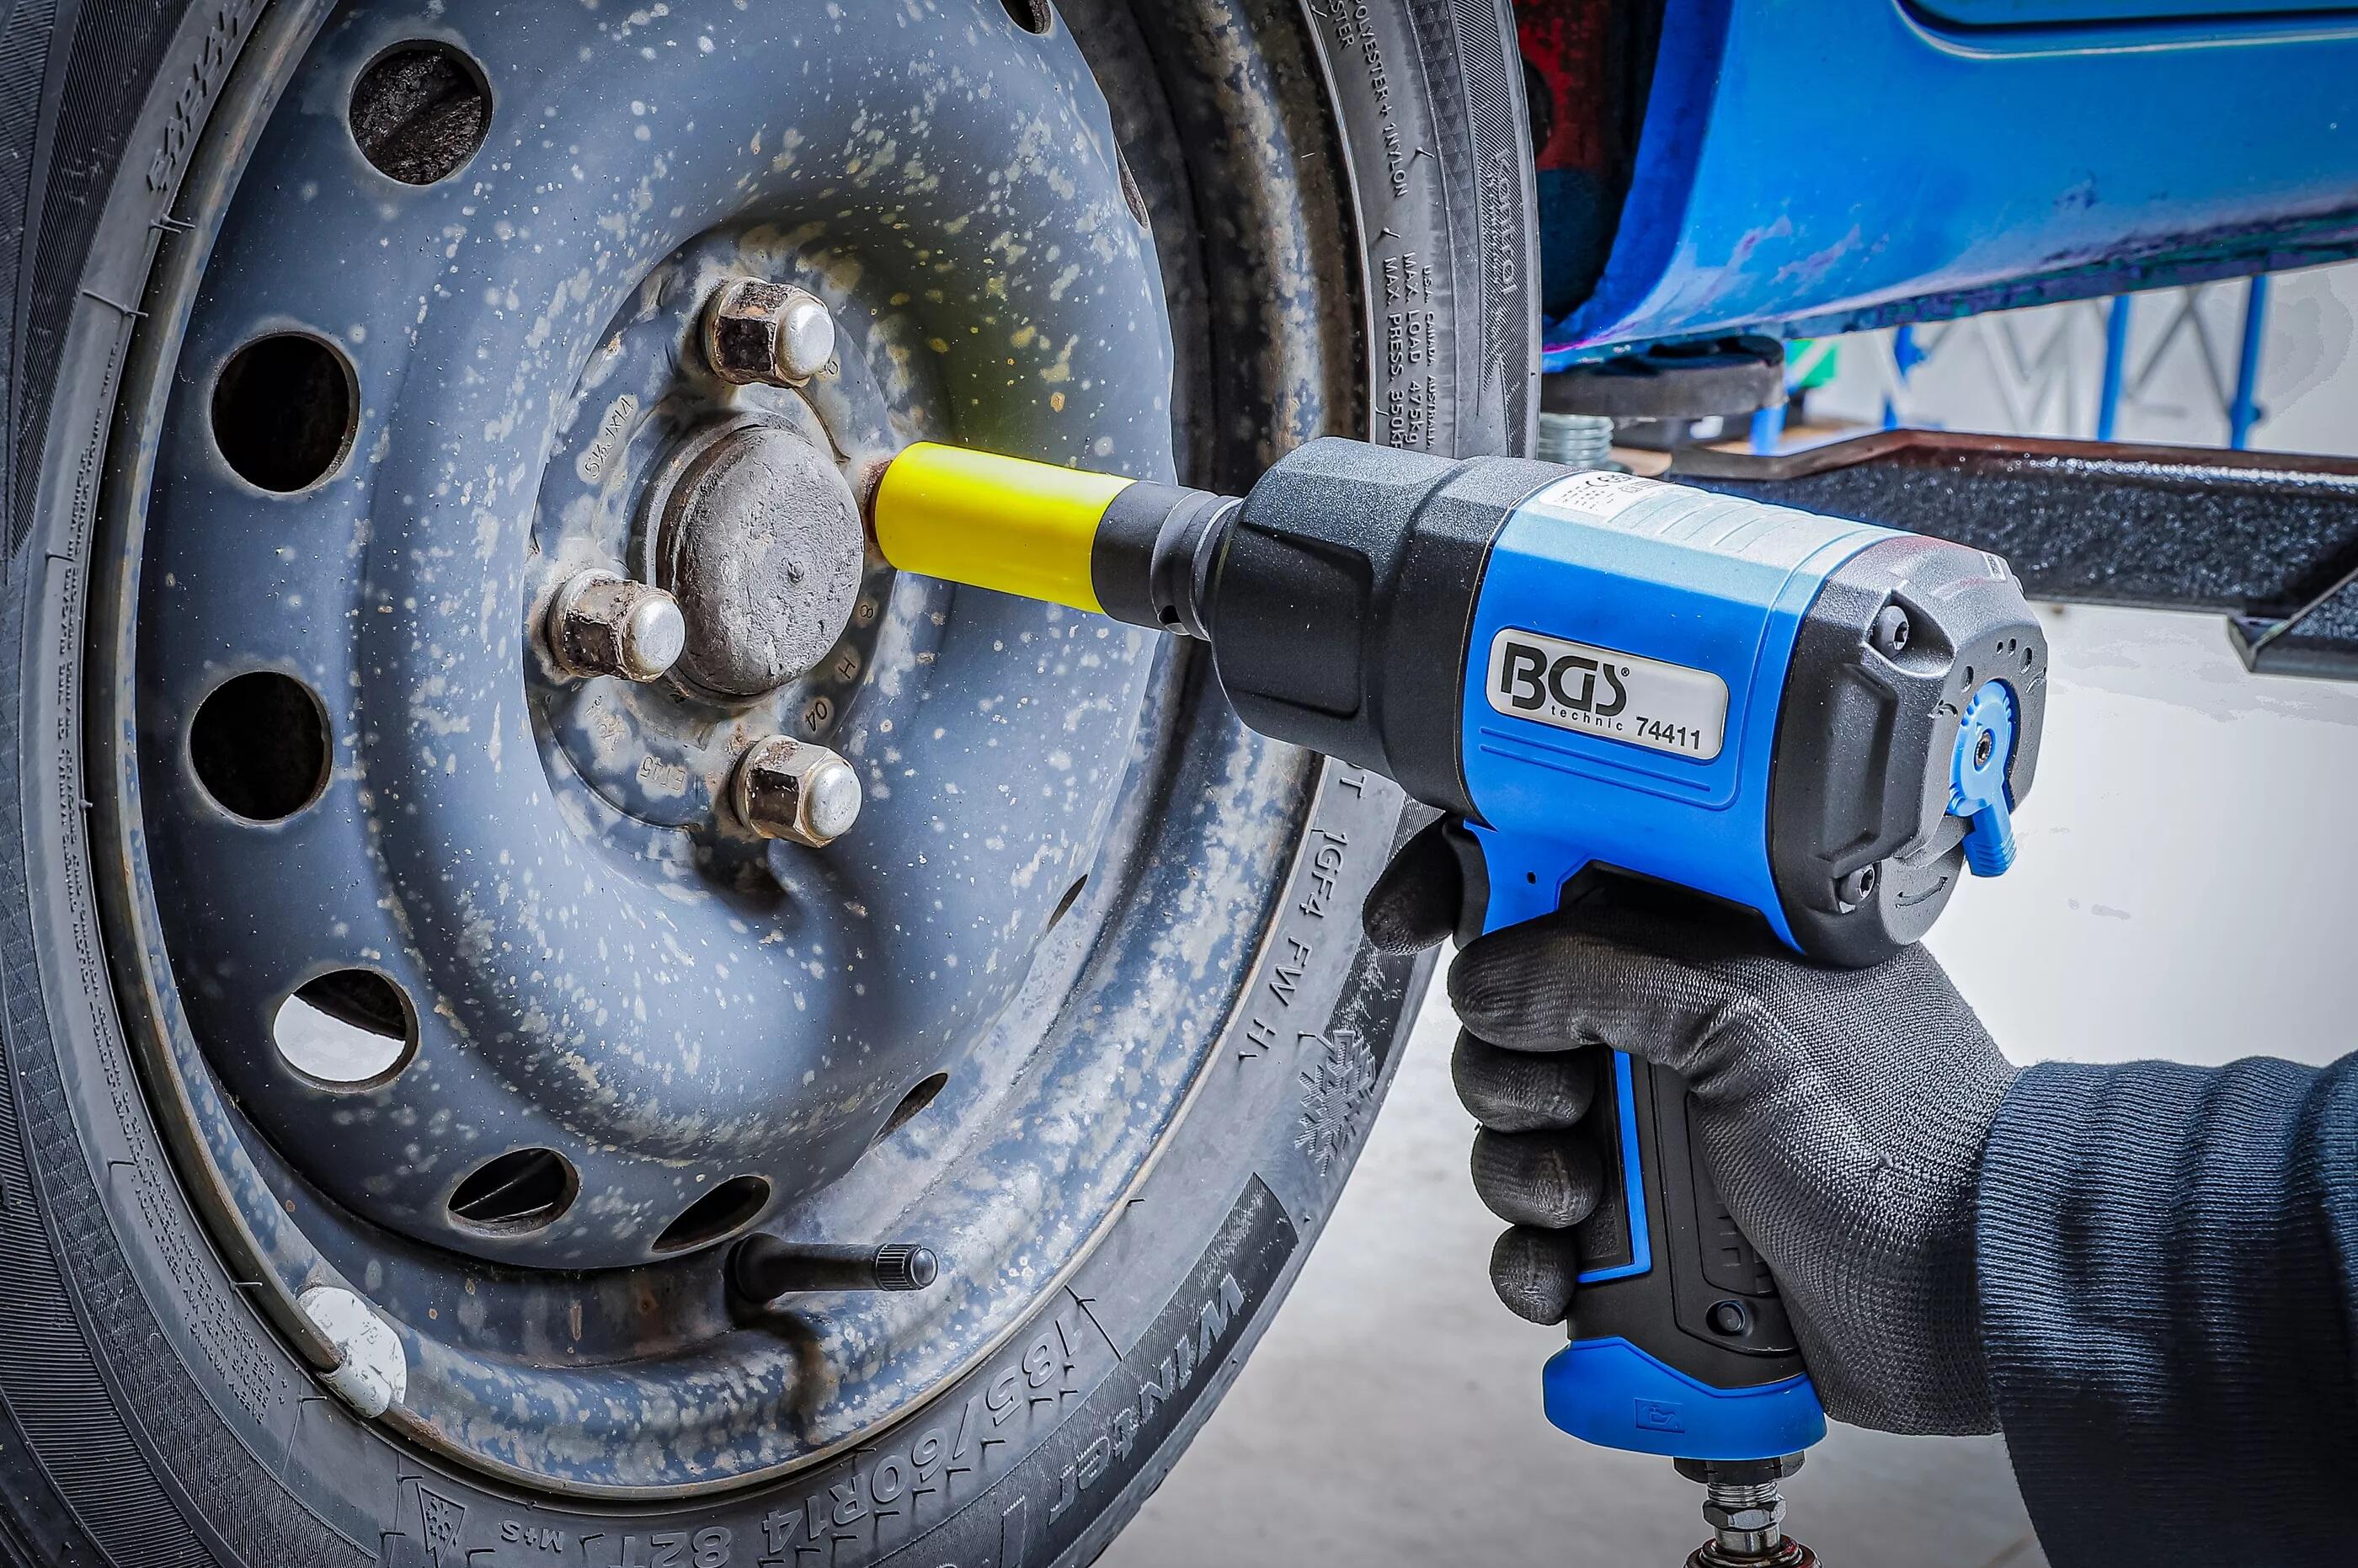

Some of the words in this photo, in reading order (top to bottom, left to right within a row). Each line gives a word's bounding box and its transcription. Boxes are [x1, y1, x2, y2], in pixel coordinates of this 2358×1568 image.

[1328, 0, 1355, 50] STER
[1354, 0, 1389, 102] OLYESTER
[1384, 257, 1400, 306] MAX.
[1403, 252, 1419, 304] MAX.
[1389, 312, 1404, 382] PRESS.
[1406, 309, 1422, 363] LOAD
[1404, 380, 1424, 444] 475kg
[1551, 705, 1623, 731] technic
[1636, 716, 1700, 749] 74411
[1299, 829, 1350, 920] 1GF4
[1269, 936, 1313, 1007] FW
[762, 1311, 1083, 1555] 185/60R14
[501, 1519, 564, 1553] M+S
